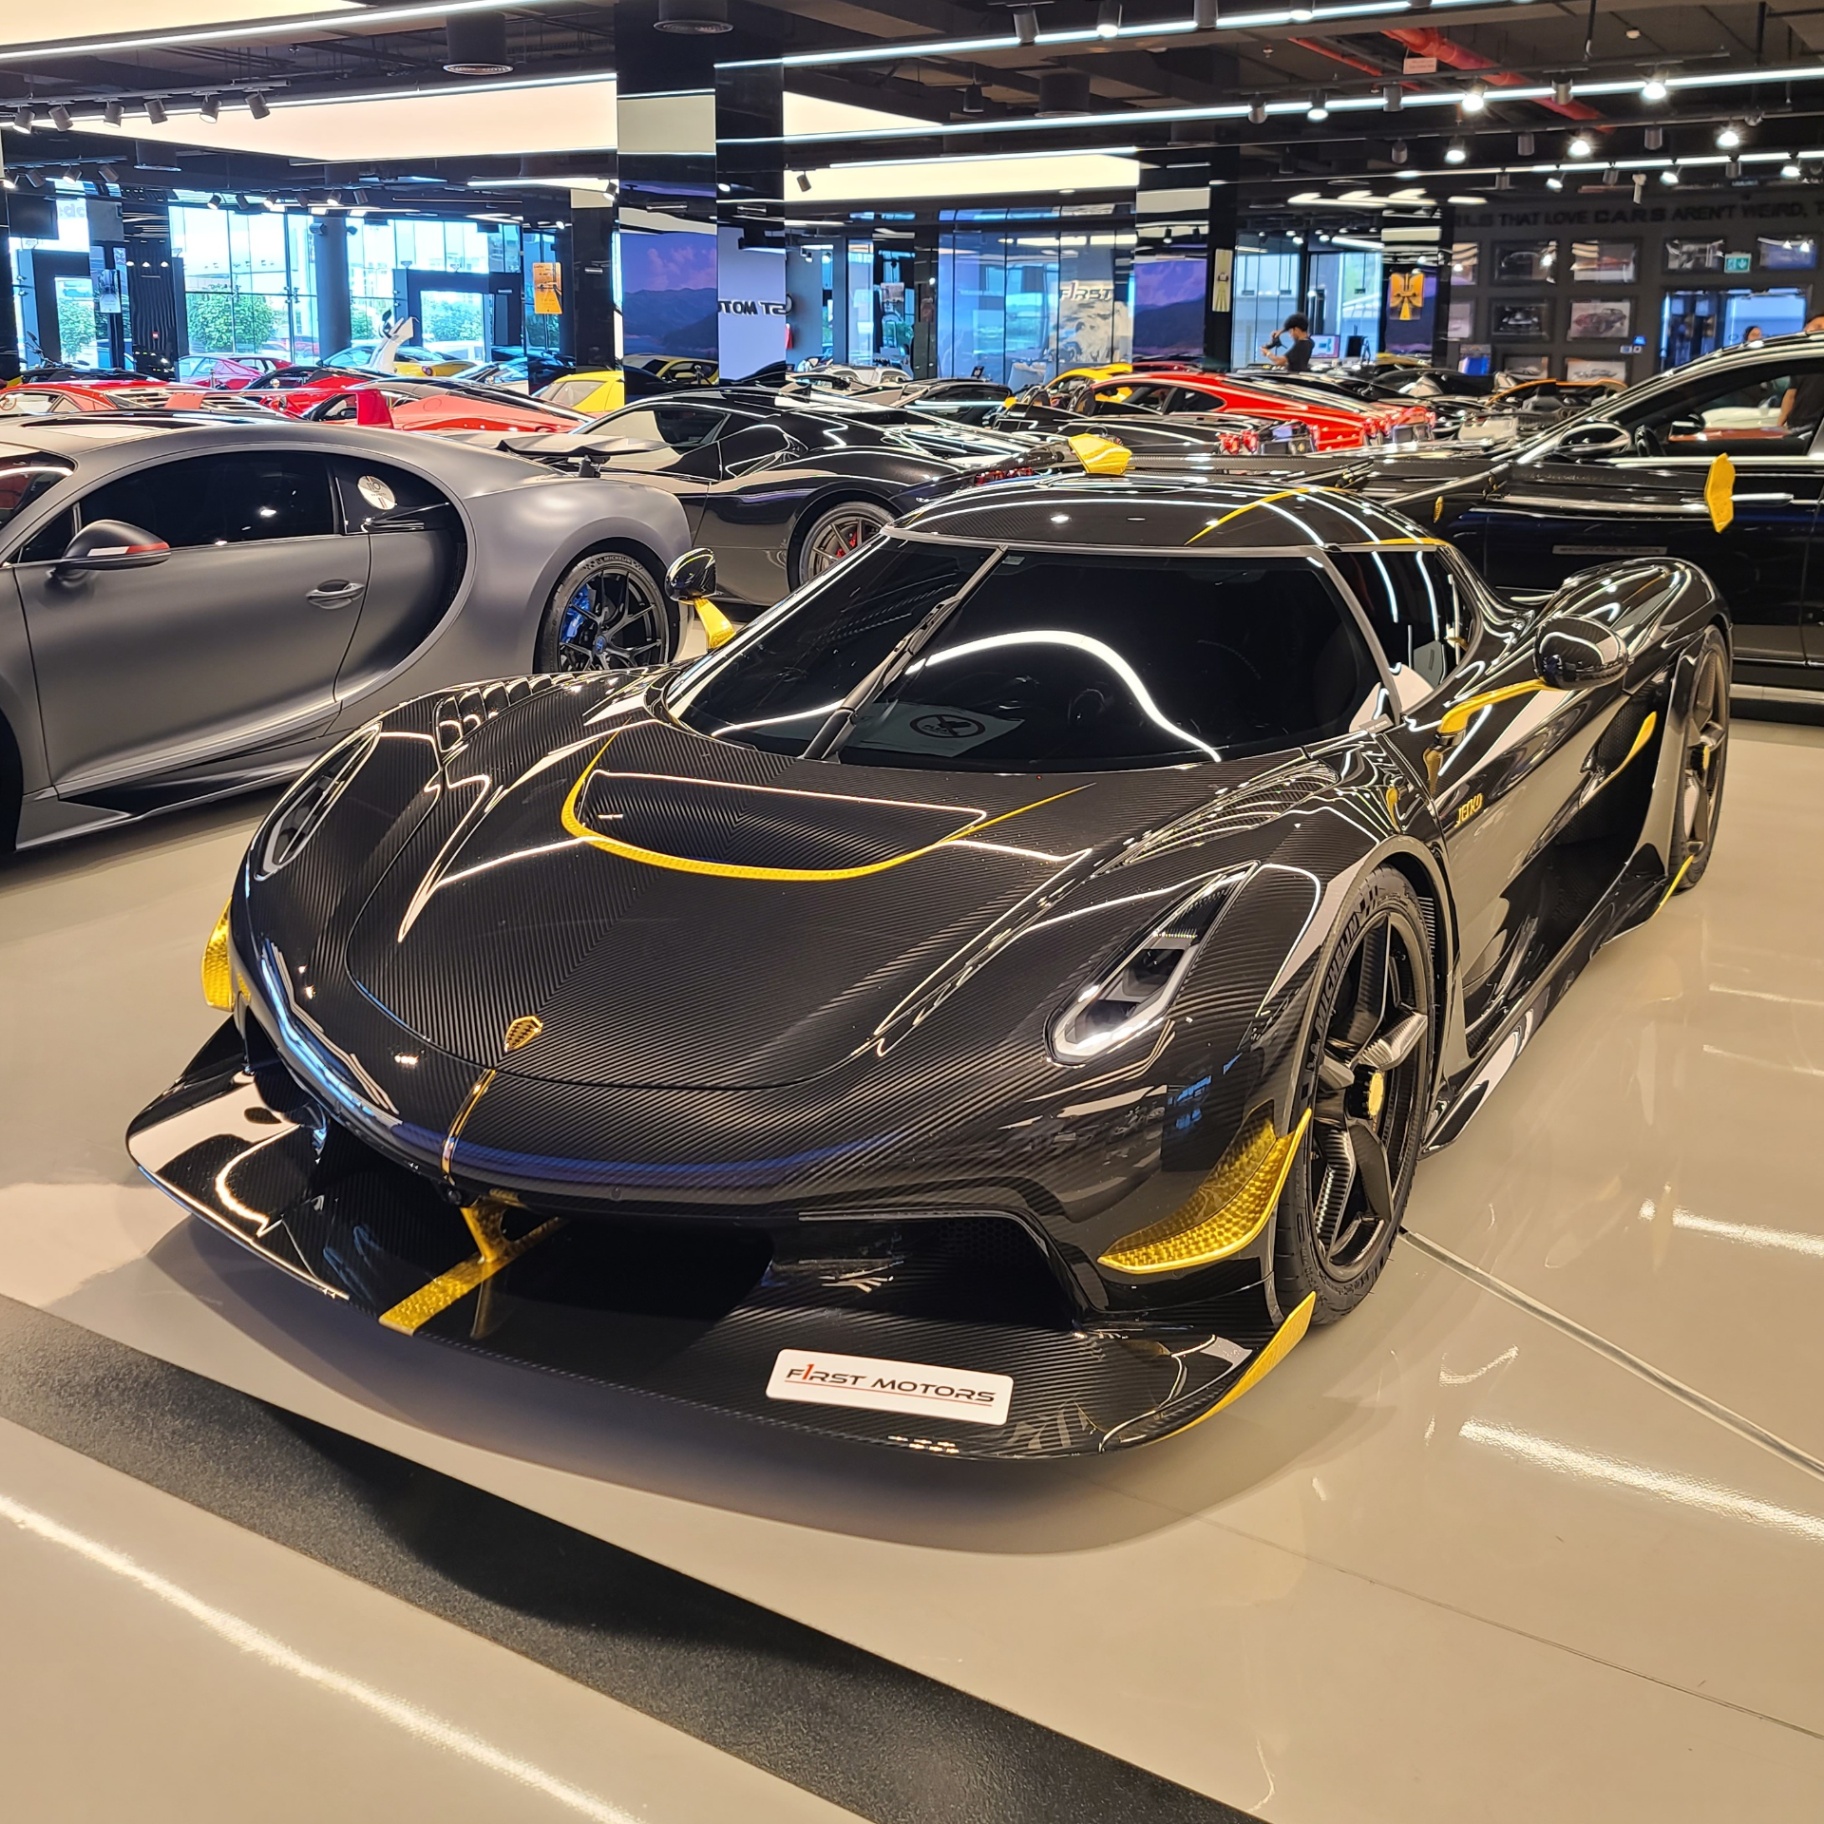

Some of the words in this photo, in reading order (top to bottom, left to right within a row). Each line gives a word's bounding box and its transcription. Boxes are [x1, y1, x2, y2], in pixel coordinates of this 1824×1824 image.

[1498, 211, 1540, 226] THAT
[1544, 209, 1588, 225] LOVE
[1594, 207, 1667, 224] CARS
[1314, 913, 1360, 1036] MICHELIN
[871, 1377, 996, 1403] MOTORS
